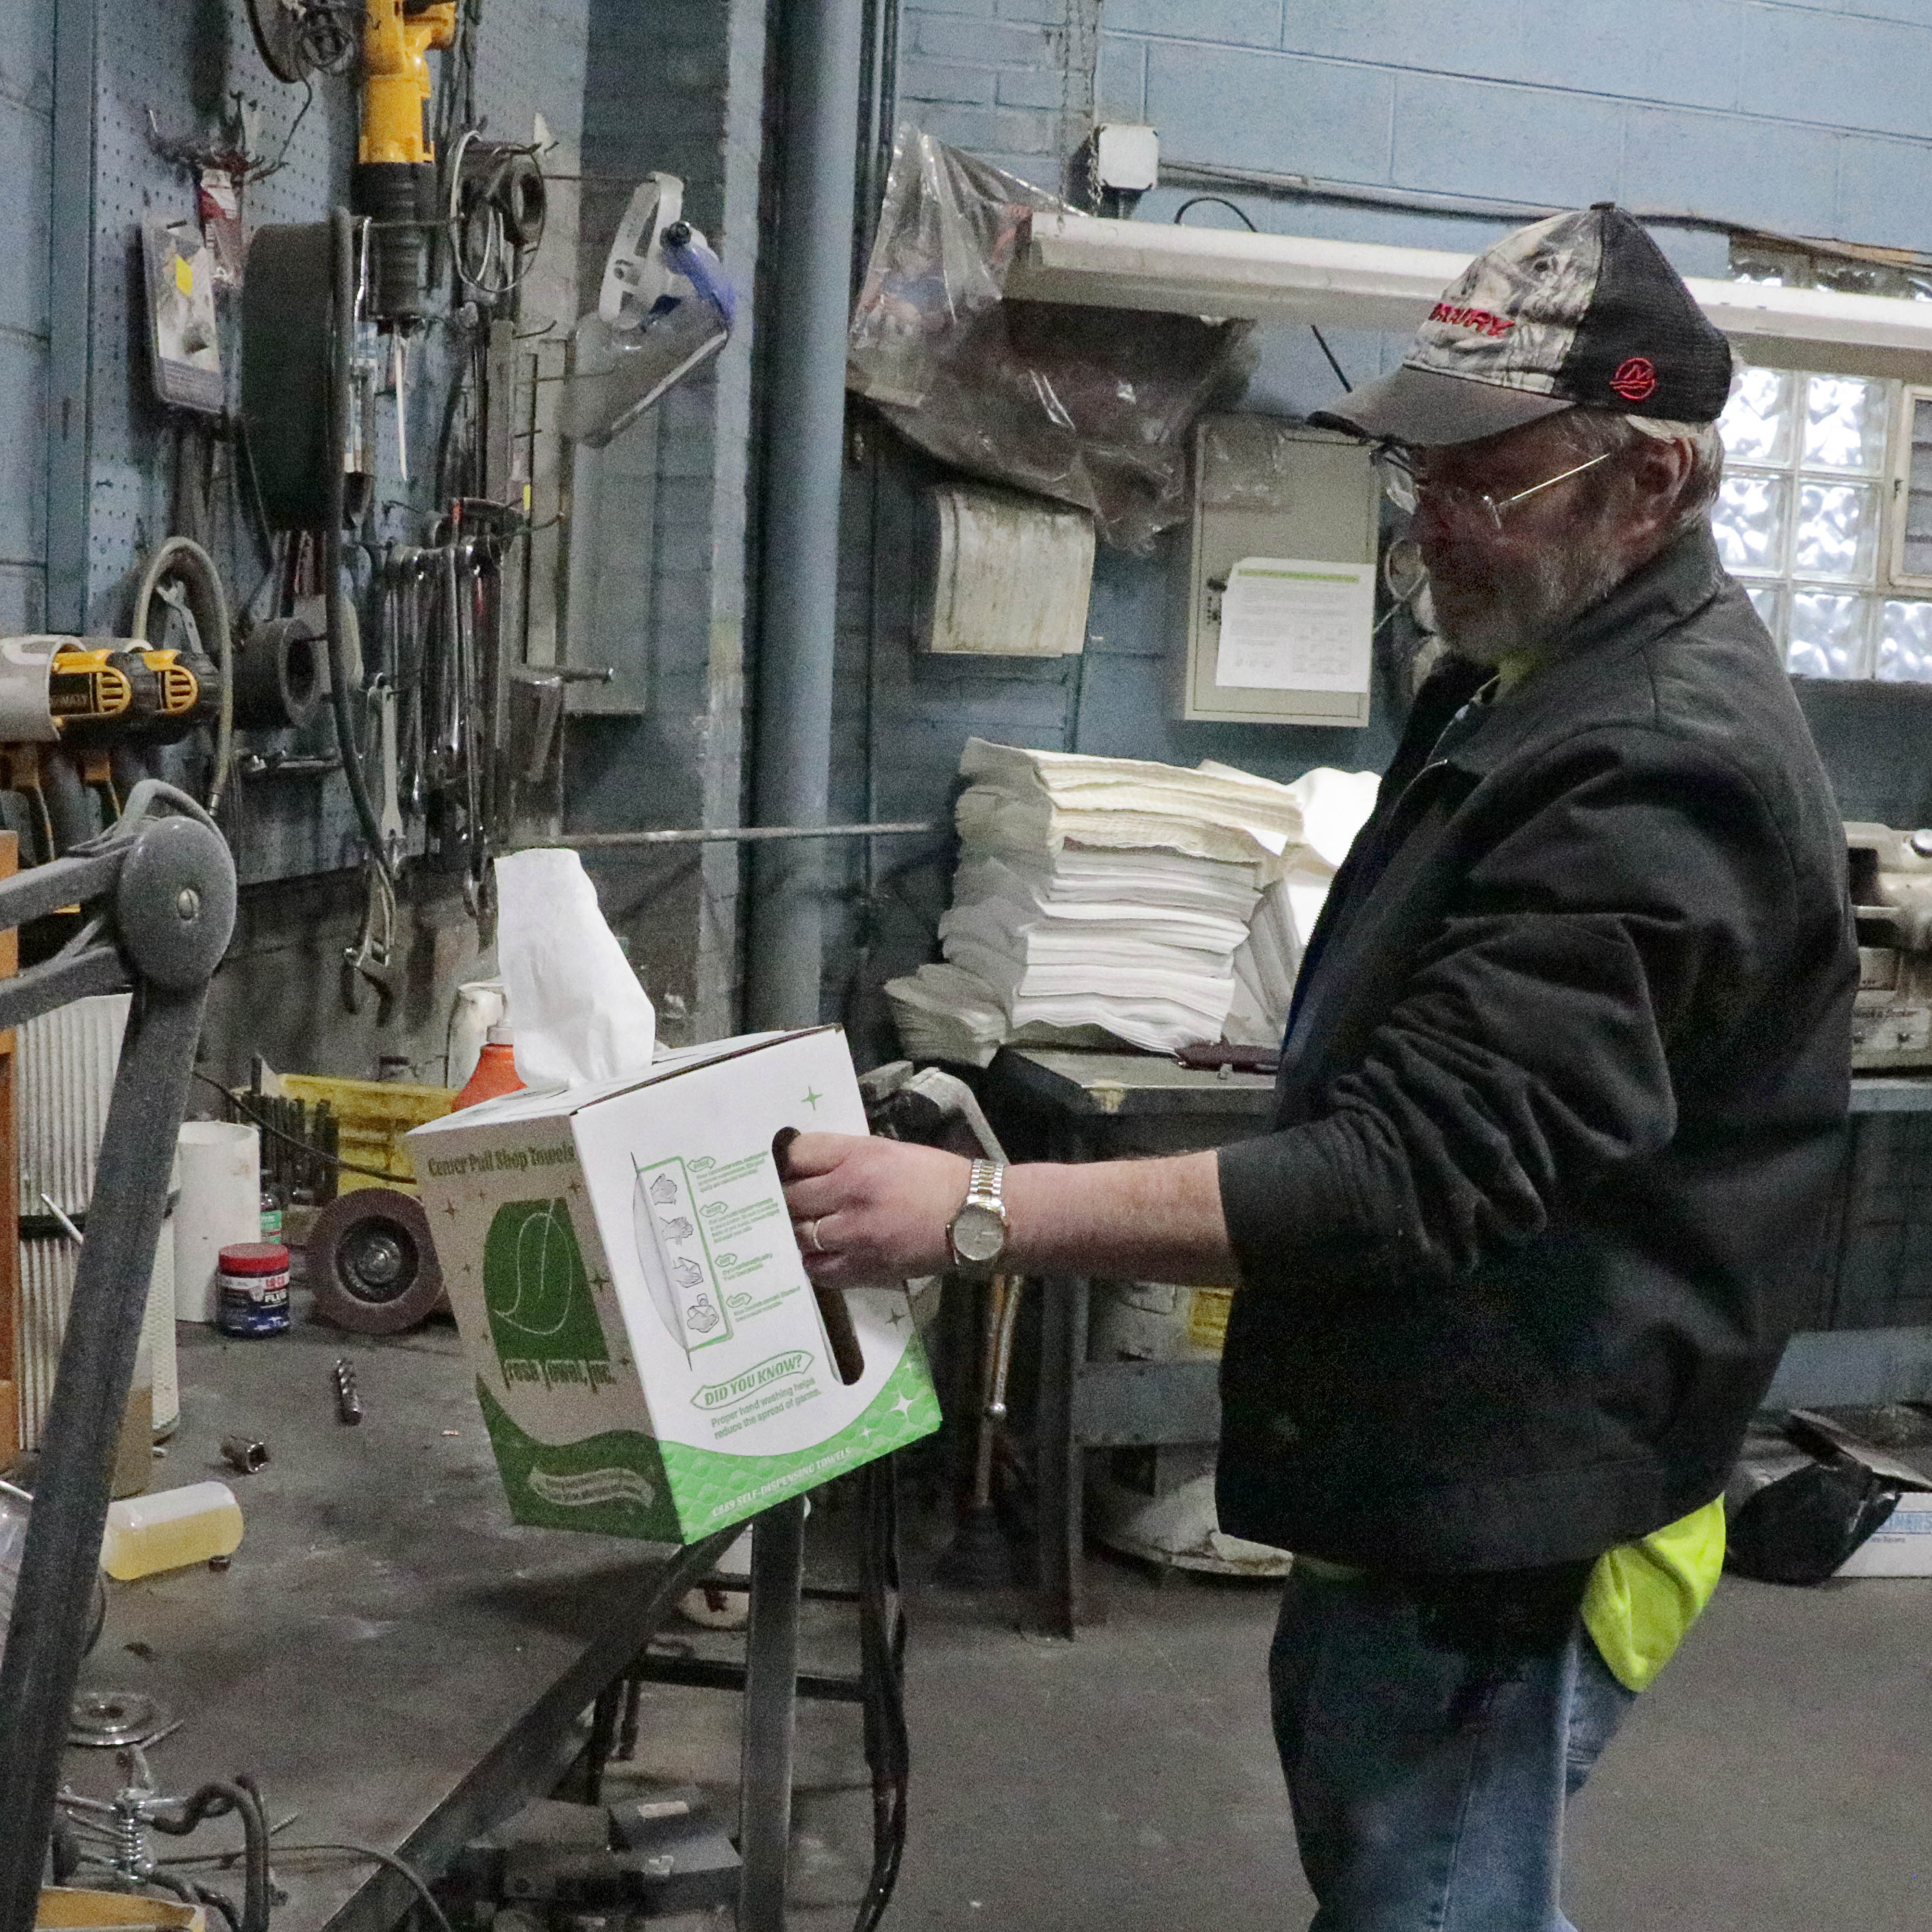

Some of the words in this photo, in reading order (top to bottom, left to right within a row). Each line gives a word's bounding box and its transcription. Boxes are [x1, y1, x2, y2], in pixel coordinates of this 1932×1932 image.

[704, 1387, 728, 1406] DID
[729, 1374, 755, 1395] YOU
[758, 1354, 802, 1384] KNOW?
[711, 1410, 739, 1428] Proper
[739, 1399, 760, 1415] hand
[760, 1387, 793, 1406] washing
[793, 1377, 816, 1391] helps
[714, 1422, 742, 1439] reduce
[742, 1417, 757, 1427] the
[757, 1403, 784, 1423] spread
[785, 1398, 794, 1409] of
[760, 1463, 815, 1496] DISPENSING
[815, 1447, 851, 1470] TOWELS
